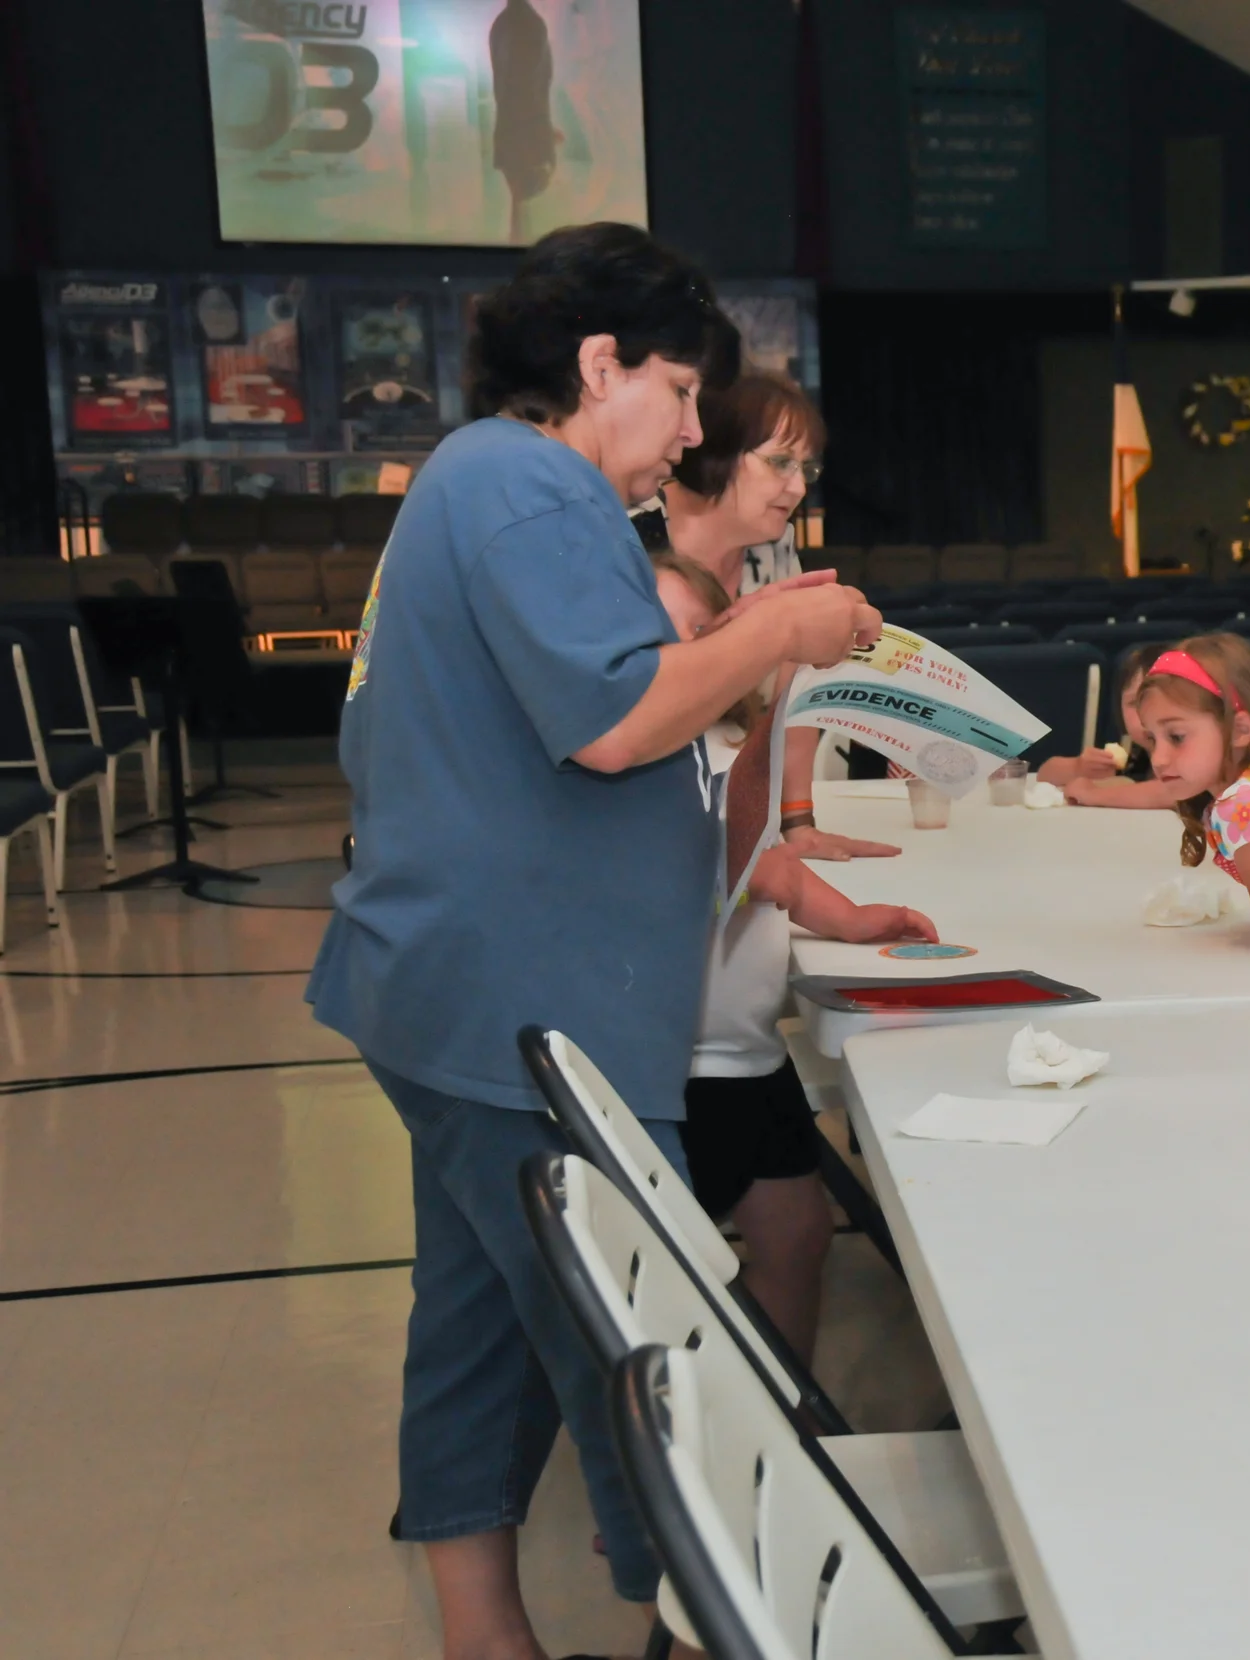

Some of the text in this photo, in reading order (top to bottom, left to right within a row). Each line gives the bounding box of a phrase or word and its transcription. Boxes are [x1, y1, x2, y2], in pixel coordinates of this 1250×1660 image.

[894, 650, 925, 665] FOR
[887, 659, 968, 693] EYES ONLY!
[808, 689, 938, 721] EVIDENCE
[816, 716, 913, 753] CONFIDENTIAL
